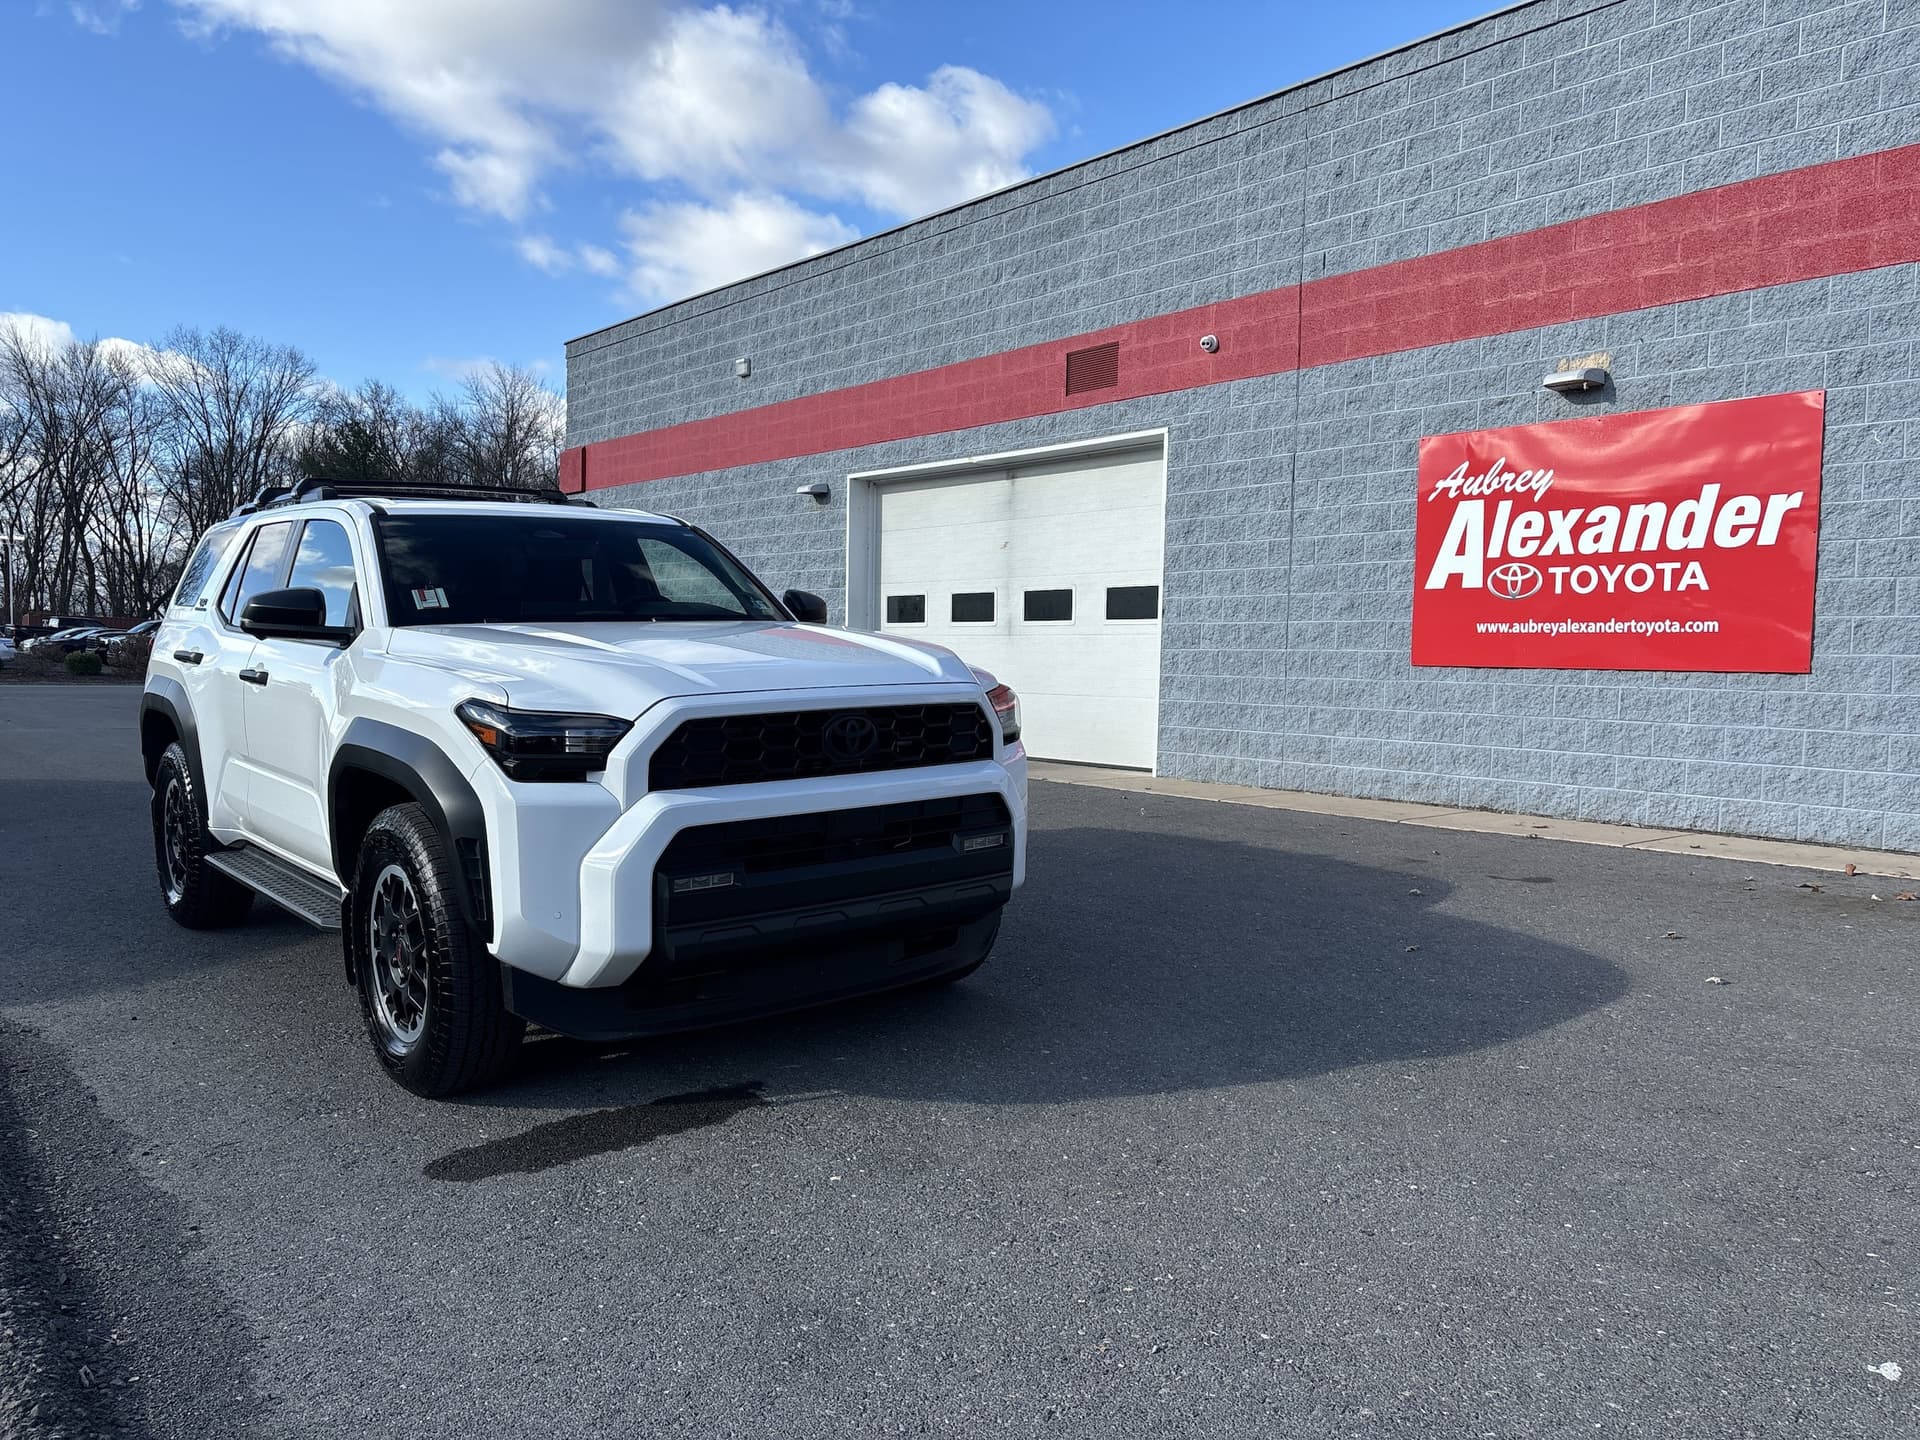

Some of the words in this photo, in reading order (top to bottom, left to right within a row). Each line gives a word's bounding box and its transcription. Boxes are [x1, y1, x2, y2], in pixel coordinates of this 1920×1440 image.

[1427, 456, 1555, 503] Aubrey
[1424, 483, 1804, 590] Alexander
[1548, 561, 1710, 594] TOYOTA
[1476, 618, 1719, 637] www.aubreyalexandertoyota.com
